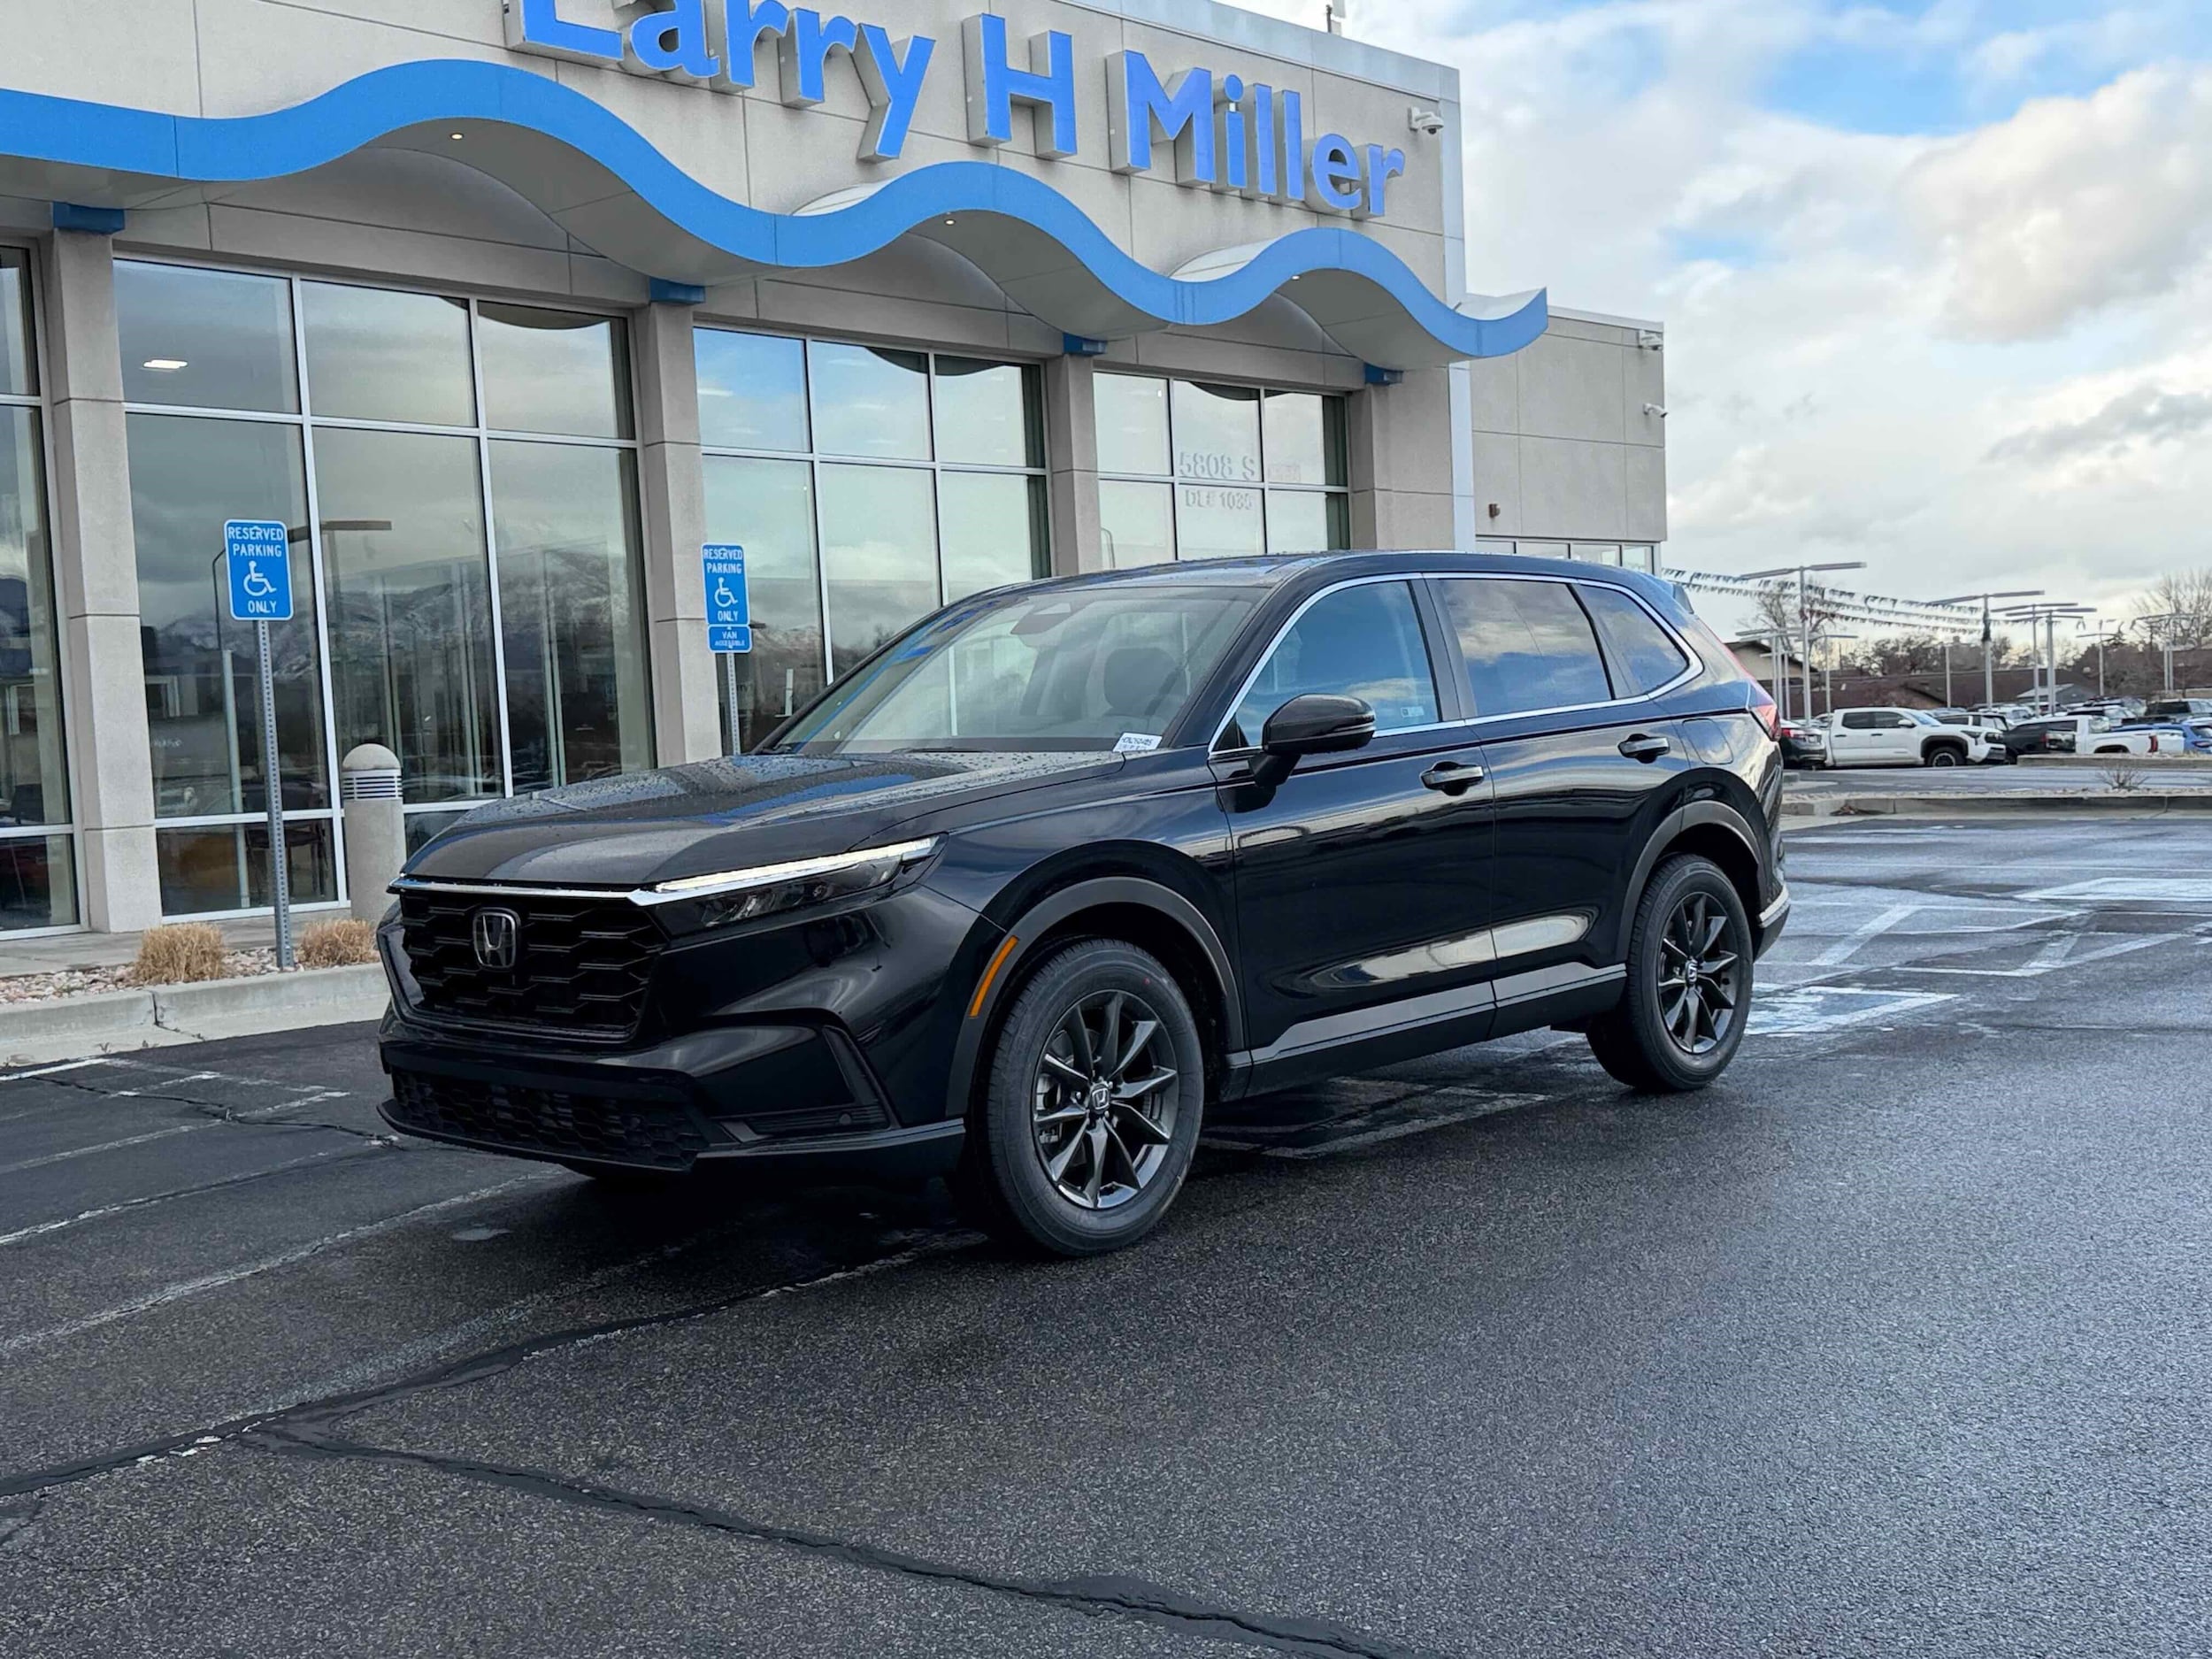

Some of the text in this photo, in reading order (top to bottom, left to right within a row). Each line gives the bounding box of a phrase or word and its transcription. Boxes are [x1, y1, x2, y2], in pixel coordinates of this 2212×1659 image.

[979, 12, 1078, 156] H
[1122, 50, 1406, 218] Miller
[227, 526, 284, 541] RESERVED
[232, 542, 282, 557] PARKING
[703, 548, 743, 560] RESERVED
[706, 562, 742, 574] PARKING
[247, 600, 277, 613] ONLY
[717, 610, 739, 622] ONLY
[721, 630, 738, 640] VAN
